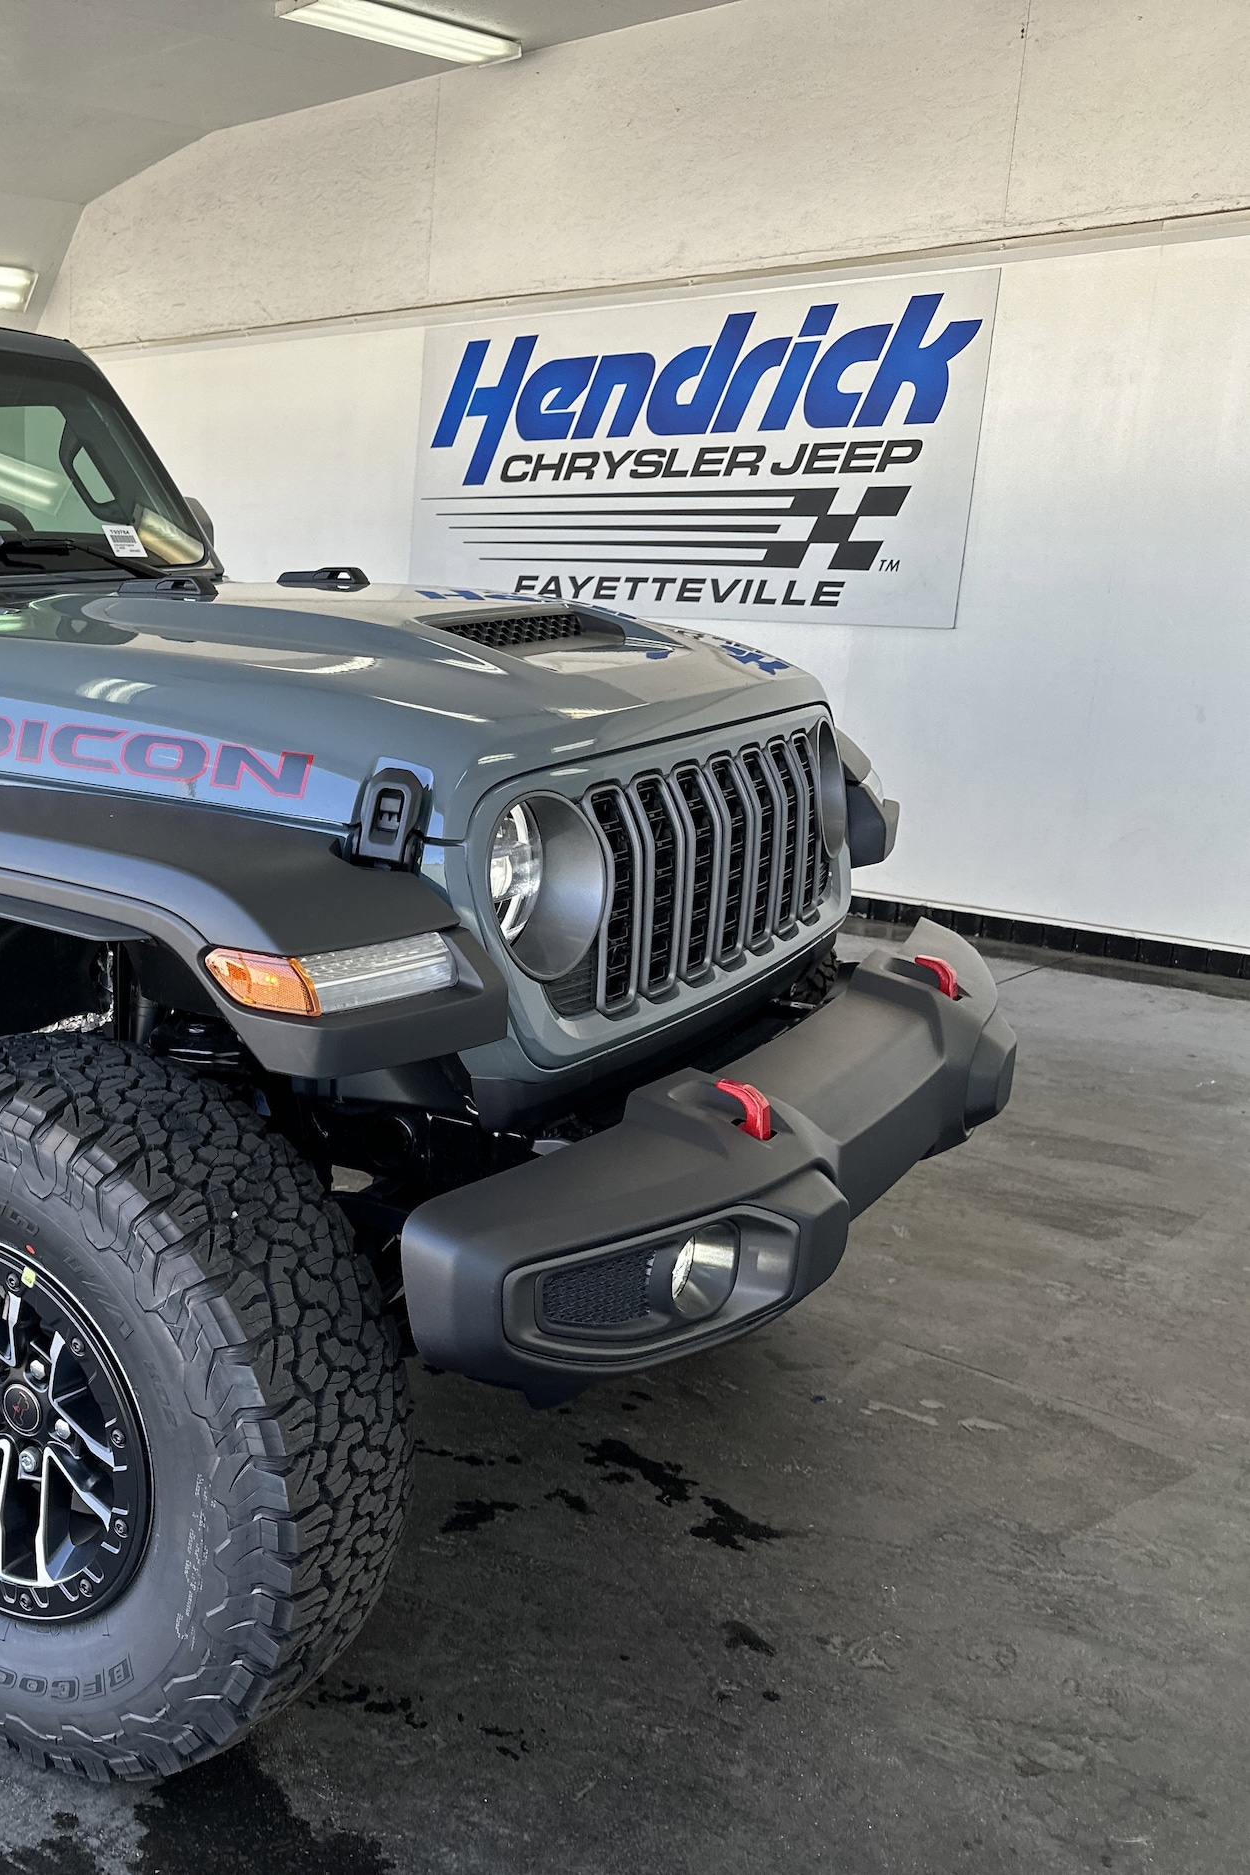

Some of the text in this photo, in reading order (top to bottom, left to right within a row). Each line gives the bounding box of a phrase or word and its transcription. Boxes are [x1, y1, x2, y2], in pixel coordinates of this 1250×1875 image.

[430, 292, 983, 486] Hendrick
[500, 438, 924, 483] CHRYSLER JEEP
[514, 574, 847, 608] FAYETTEVILLE
